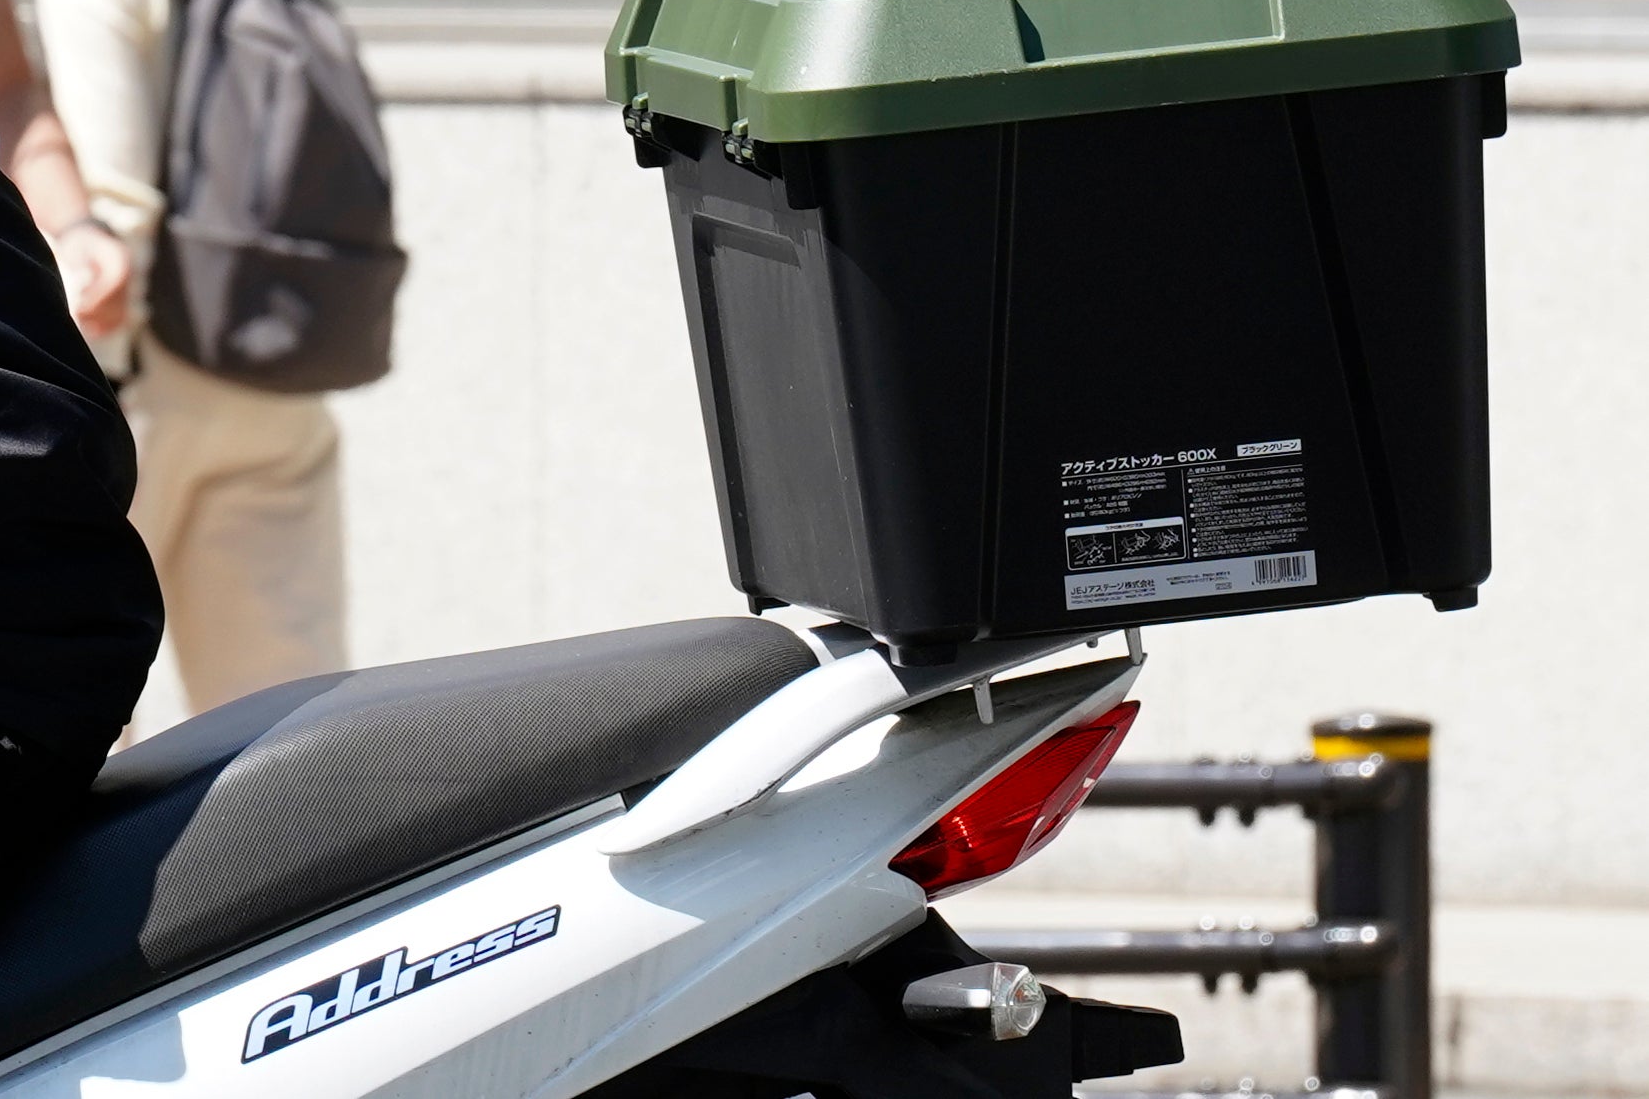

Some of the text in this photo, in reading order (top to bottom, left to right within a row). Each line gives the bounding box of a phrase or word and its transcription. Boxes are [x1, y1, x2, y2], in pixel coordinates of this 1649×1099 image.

[1061, 447, 1217, 475] アクティブストッカー 600X
[1241, 441, 1297, 455] ブラックグリーン
[243, 906, 558, 1061] Address
